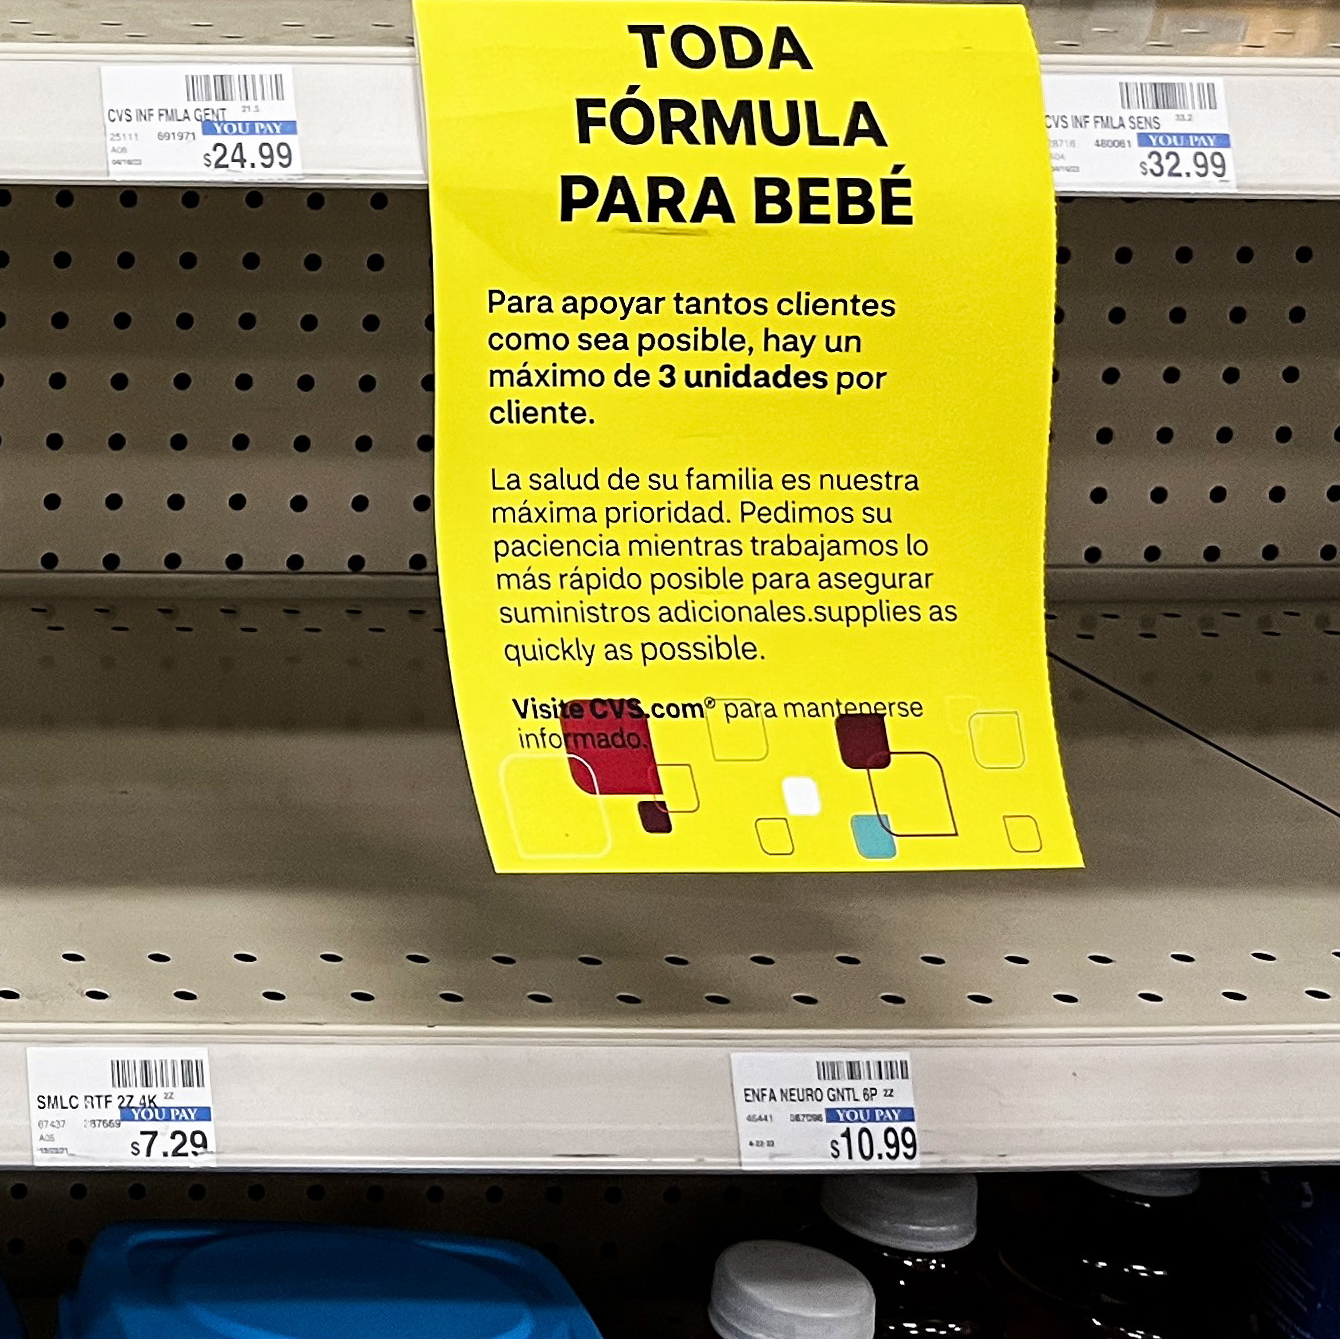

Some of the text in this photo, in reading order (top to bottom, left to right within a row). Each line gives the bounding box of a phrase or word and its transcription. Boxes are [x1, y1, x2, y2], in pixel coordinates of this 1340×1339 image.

[628, 25, 813, 69] TODA
[107, 108, 132, 122] CVS
[576, 85, 888, 147] FÓRMULA
[1044, 115, 1161, 130] CVS SENS
[1148, 135, 1216, 146] YOU PAY
[203, 142, 293, 169] $24.99
[1140, 151, 1226, 178] $32.99
[561, 164, 913, 225] PARA BEBÉ
[489, 290, 895, 320] Para apoyar tantos clientes
[489, 327, 860, 358] como sea posible, hay un
[490, 362, 887, 395] máximo de 3 unidades por
[490, 400, 594, 424] cliente.
[492, 467, 919, 491] La salud de su familia es nuestra
[493, 500, 892, 528] máxima prioridad. Pedimos su
[495, 534, 928, 563] paciencia mientras trabajamos lo
[497, 566, 933, 595] más rápido posible para asegurar
[500, 599, 957, 627] suministros adicionales.supplies as
[505, 635, 764, 666] quickly as possible.
[511, 697, 585, 720] Visite
[723, 700, 779, 724] para
[783, 697, 923, 720] mantenerse
[518, 727, 648, 751] informado.
[37, 1095, 79, 1110] SMLC
[744, 1088, 859, 1103] ENFA NEURO GNTL
[131, 1108, 198, 1120] YOU PAY
[836, 1108, 902, 1121] YOU PAY
[130, 1130, 208, 1157] $7.29
[830, 1126, 917, 1160] $10.99
